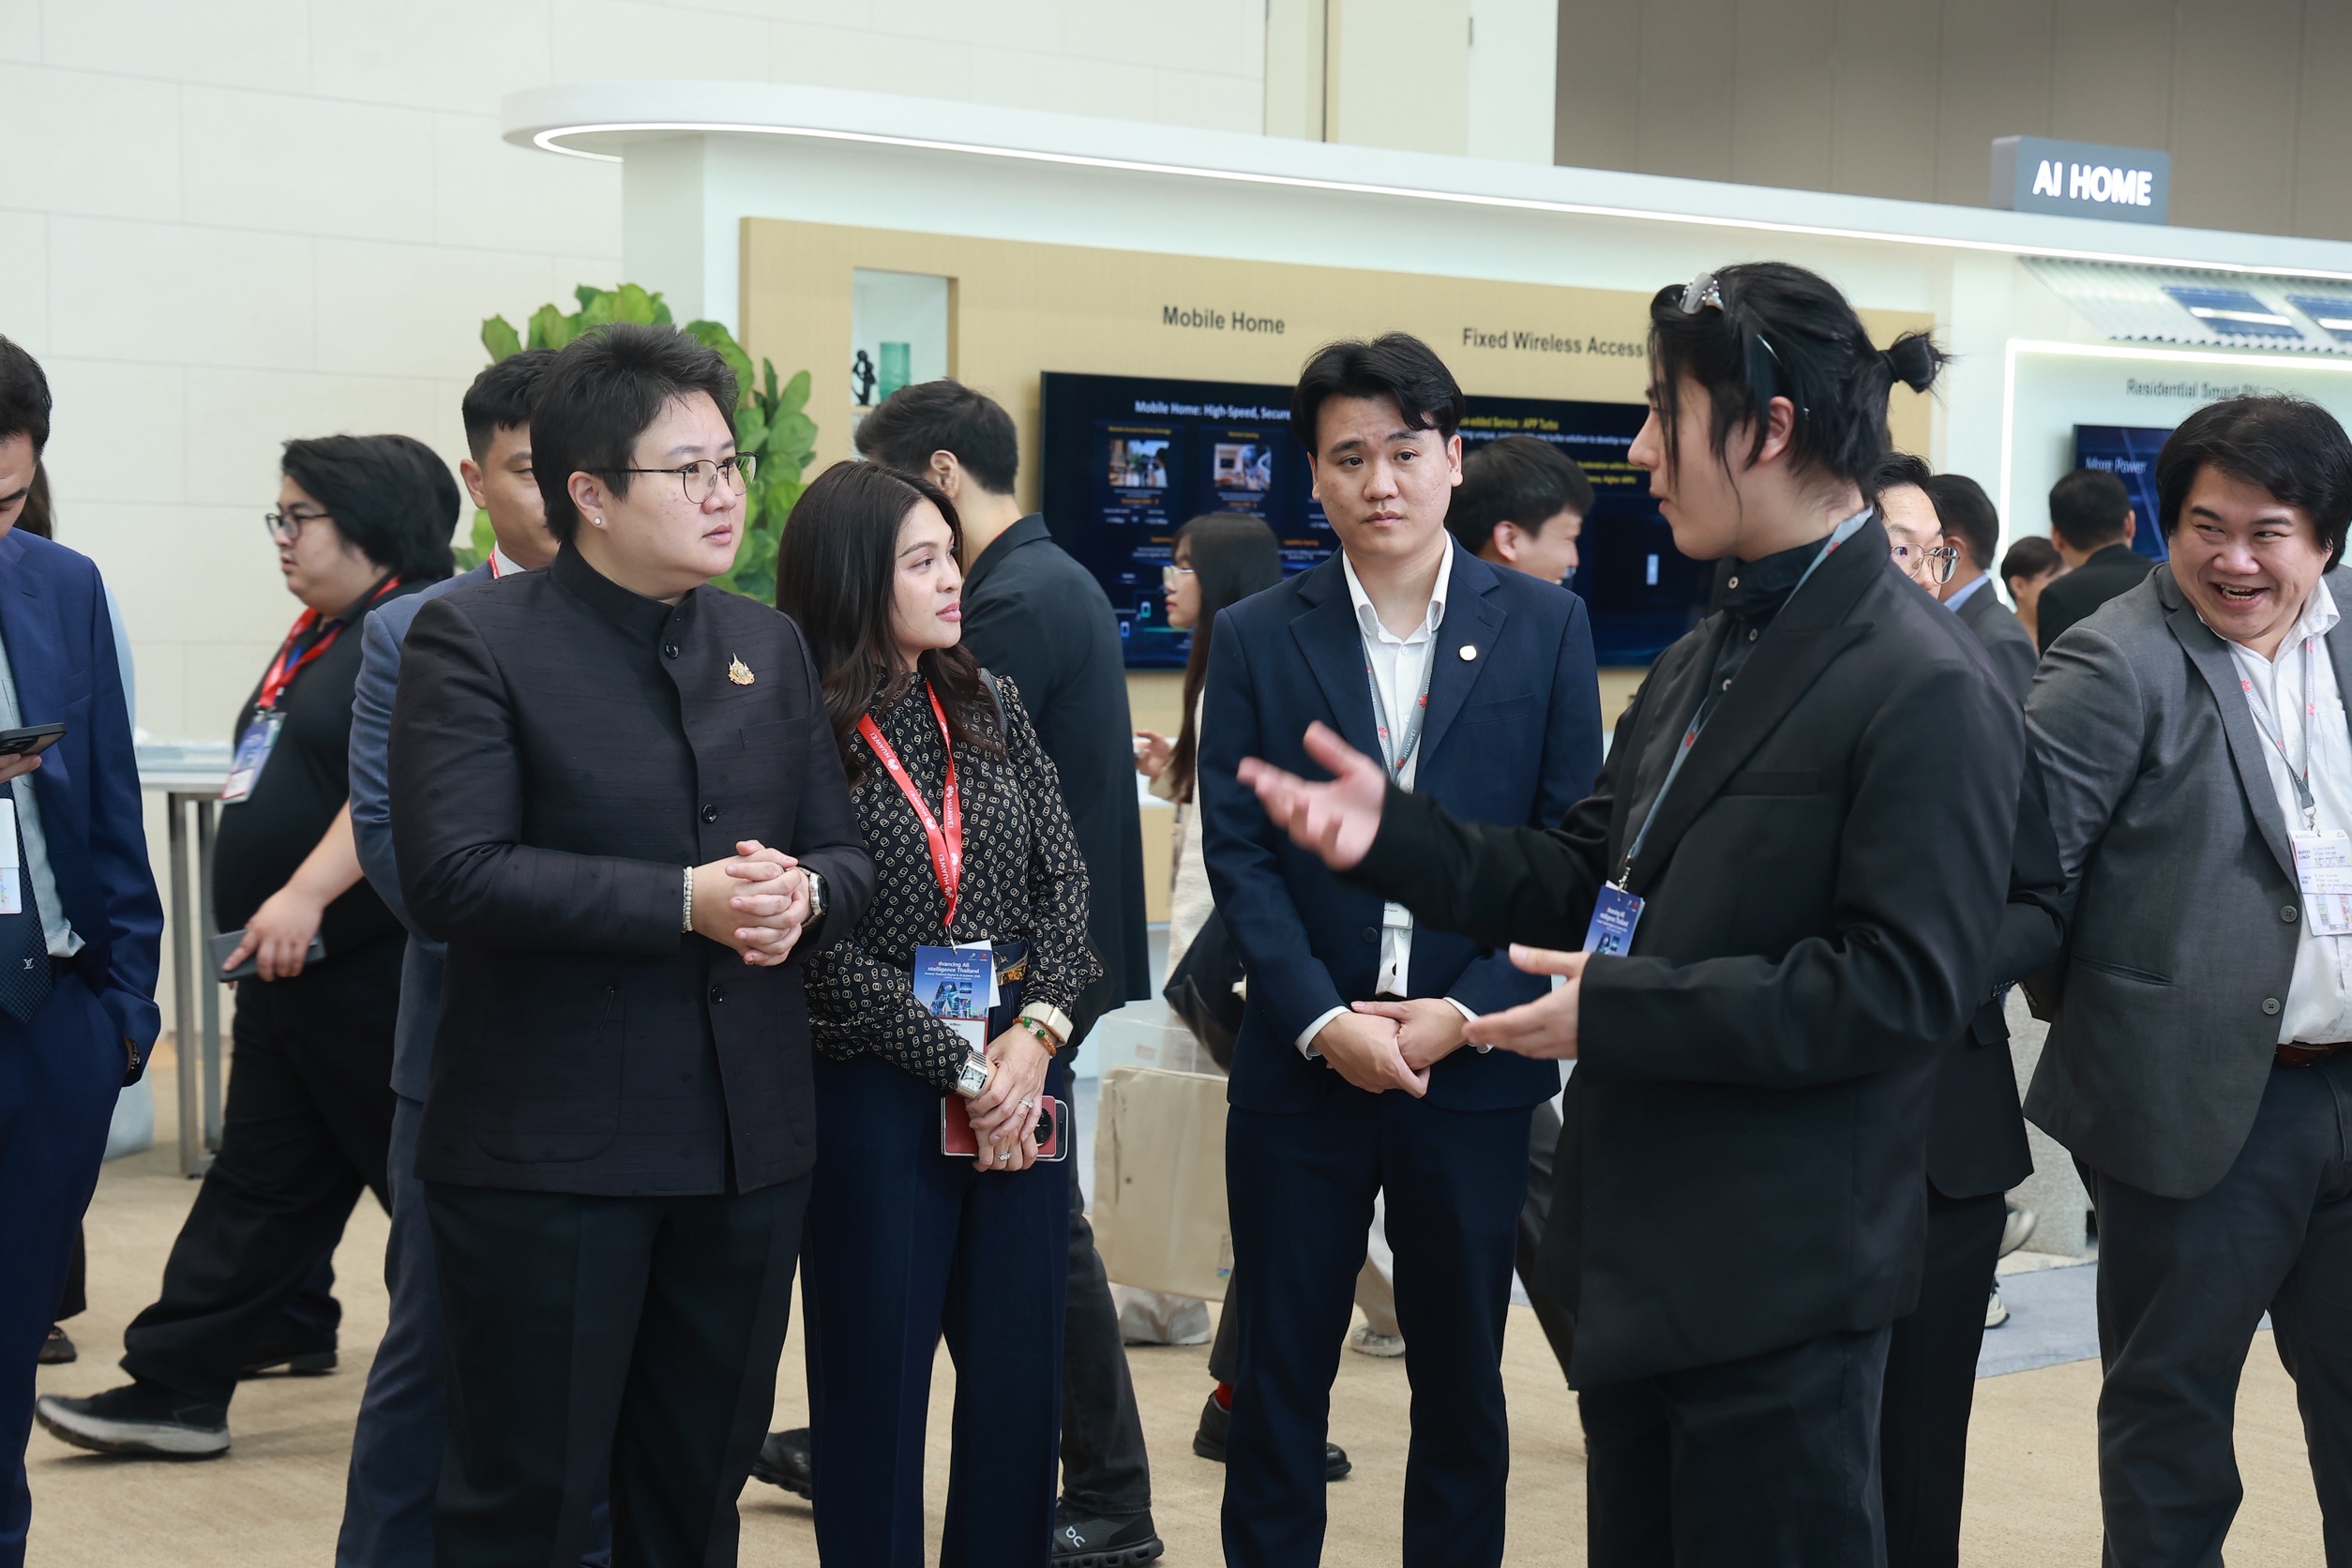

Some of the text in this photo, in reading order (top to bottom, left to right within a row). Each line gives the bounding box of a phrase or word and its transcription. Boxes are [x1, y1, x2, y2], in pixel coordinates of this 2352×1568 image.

[2032, 159, 2153, 206] AI HOME
[1163, 305, 1286, 335] Mobile Home
[1462, 327, 1646, 358] Fixed Wireless Access
[2126, 377, 2199, 399] Residential
[1134, 400, 1170, 415] Mobile
[1170, 402, 1202, 416] Home:
[1203, 403, 1259, 420] High-Speed,
[2113, 457, 2148, 475] Power
[2247, 692, 2267, 721] HUAWEI
[868, 731, 892, 759] HUAWEI
[1403, 729, 1417, 758] HUAWEI
[909, 790, 929, 818] HUAWEI
[947, 798, 956, 829] HUAWEI
[938, 853, 951, 885] HUAWEI
